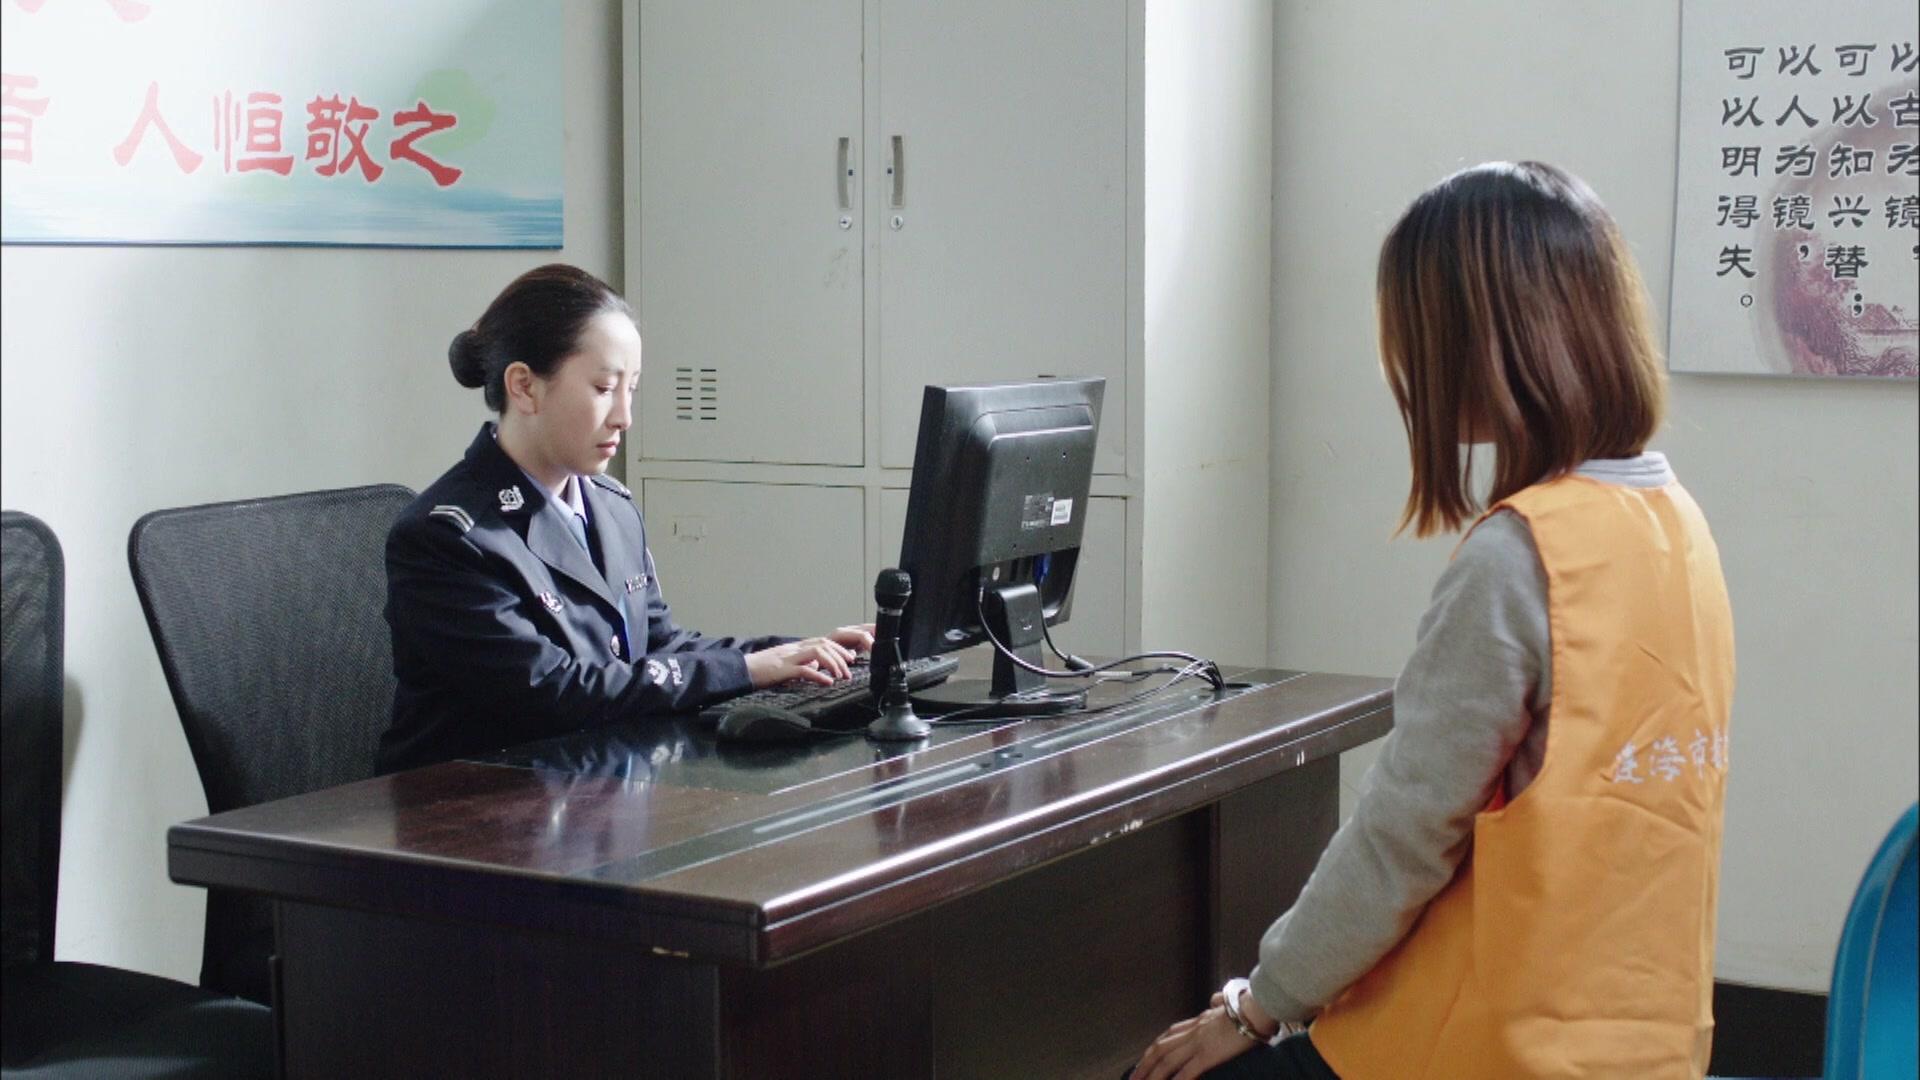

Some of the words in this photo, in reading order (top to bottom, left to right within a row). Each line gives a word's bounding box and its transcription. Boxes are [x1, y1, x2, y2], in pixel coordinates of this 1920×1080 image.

[113, 81, 463, 187] 人恒敬之
[1715, 46, 1765, 308] 可以明得失。
[1773, 44, 1822, 258] 以人为镜，
[1826, 44, 1878, 315] 可以知兴替；
